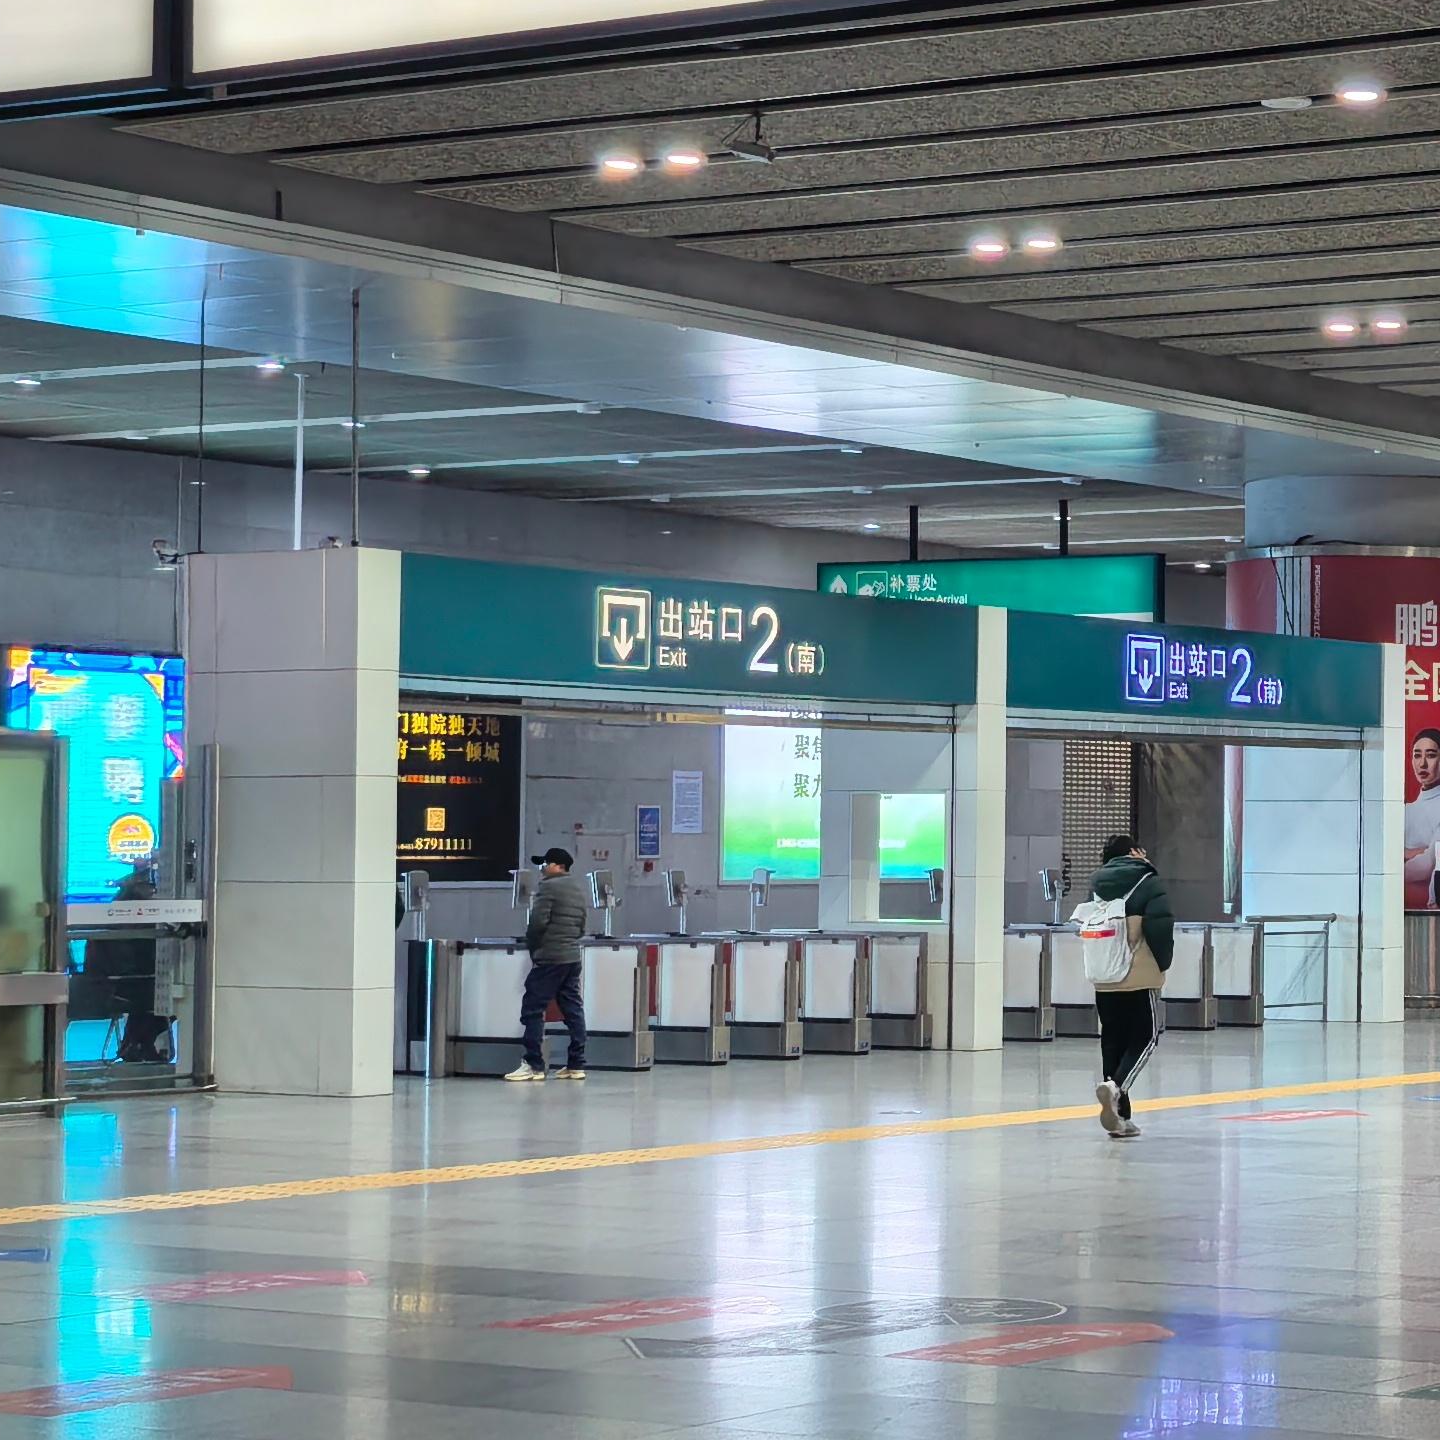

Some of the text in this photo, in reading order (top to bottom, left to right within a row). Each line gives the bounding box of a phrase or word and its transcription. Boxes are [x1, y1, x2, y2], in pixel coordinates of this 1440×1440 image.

[889, 573, 938, 592] 补票处
[659, 598, 826, 676] 出站口 2 (南)
[659, 646, 687, 668] Exit
[1169, 642, 1283, 705] 出站口 2 (南)
[1169, 681, 1189, 700] Exit
